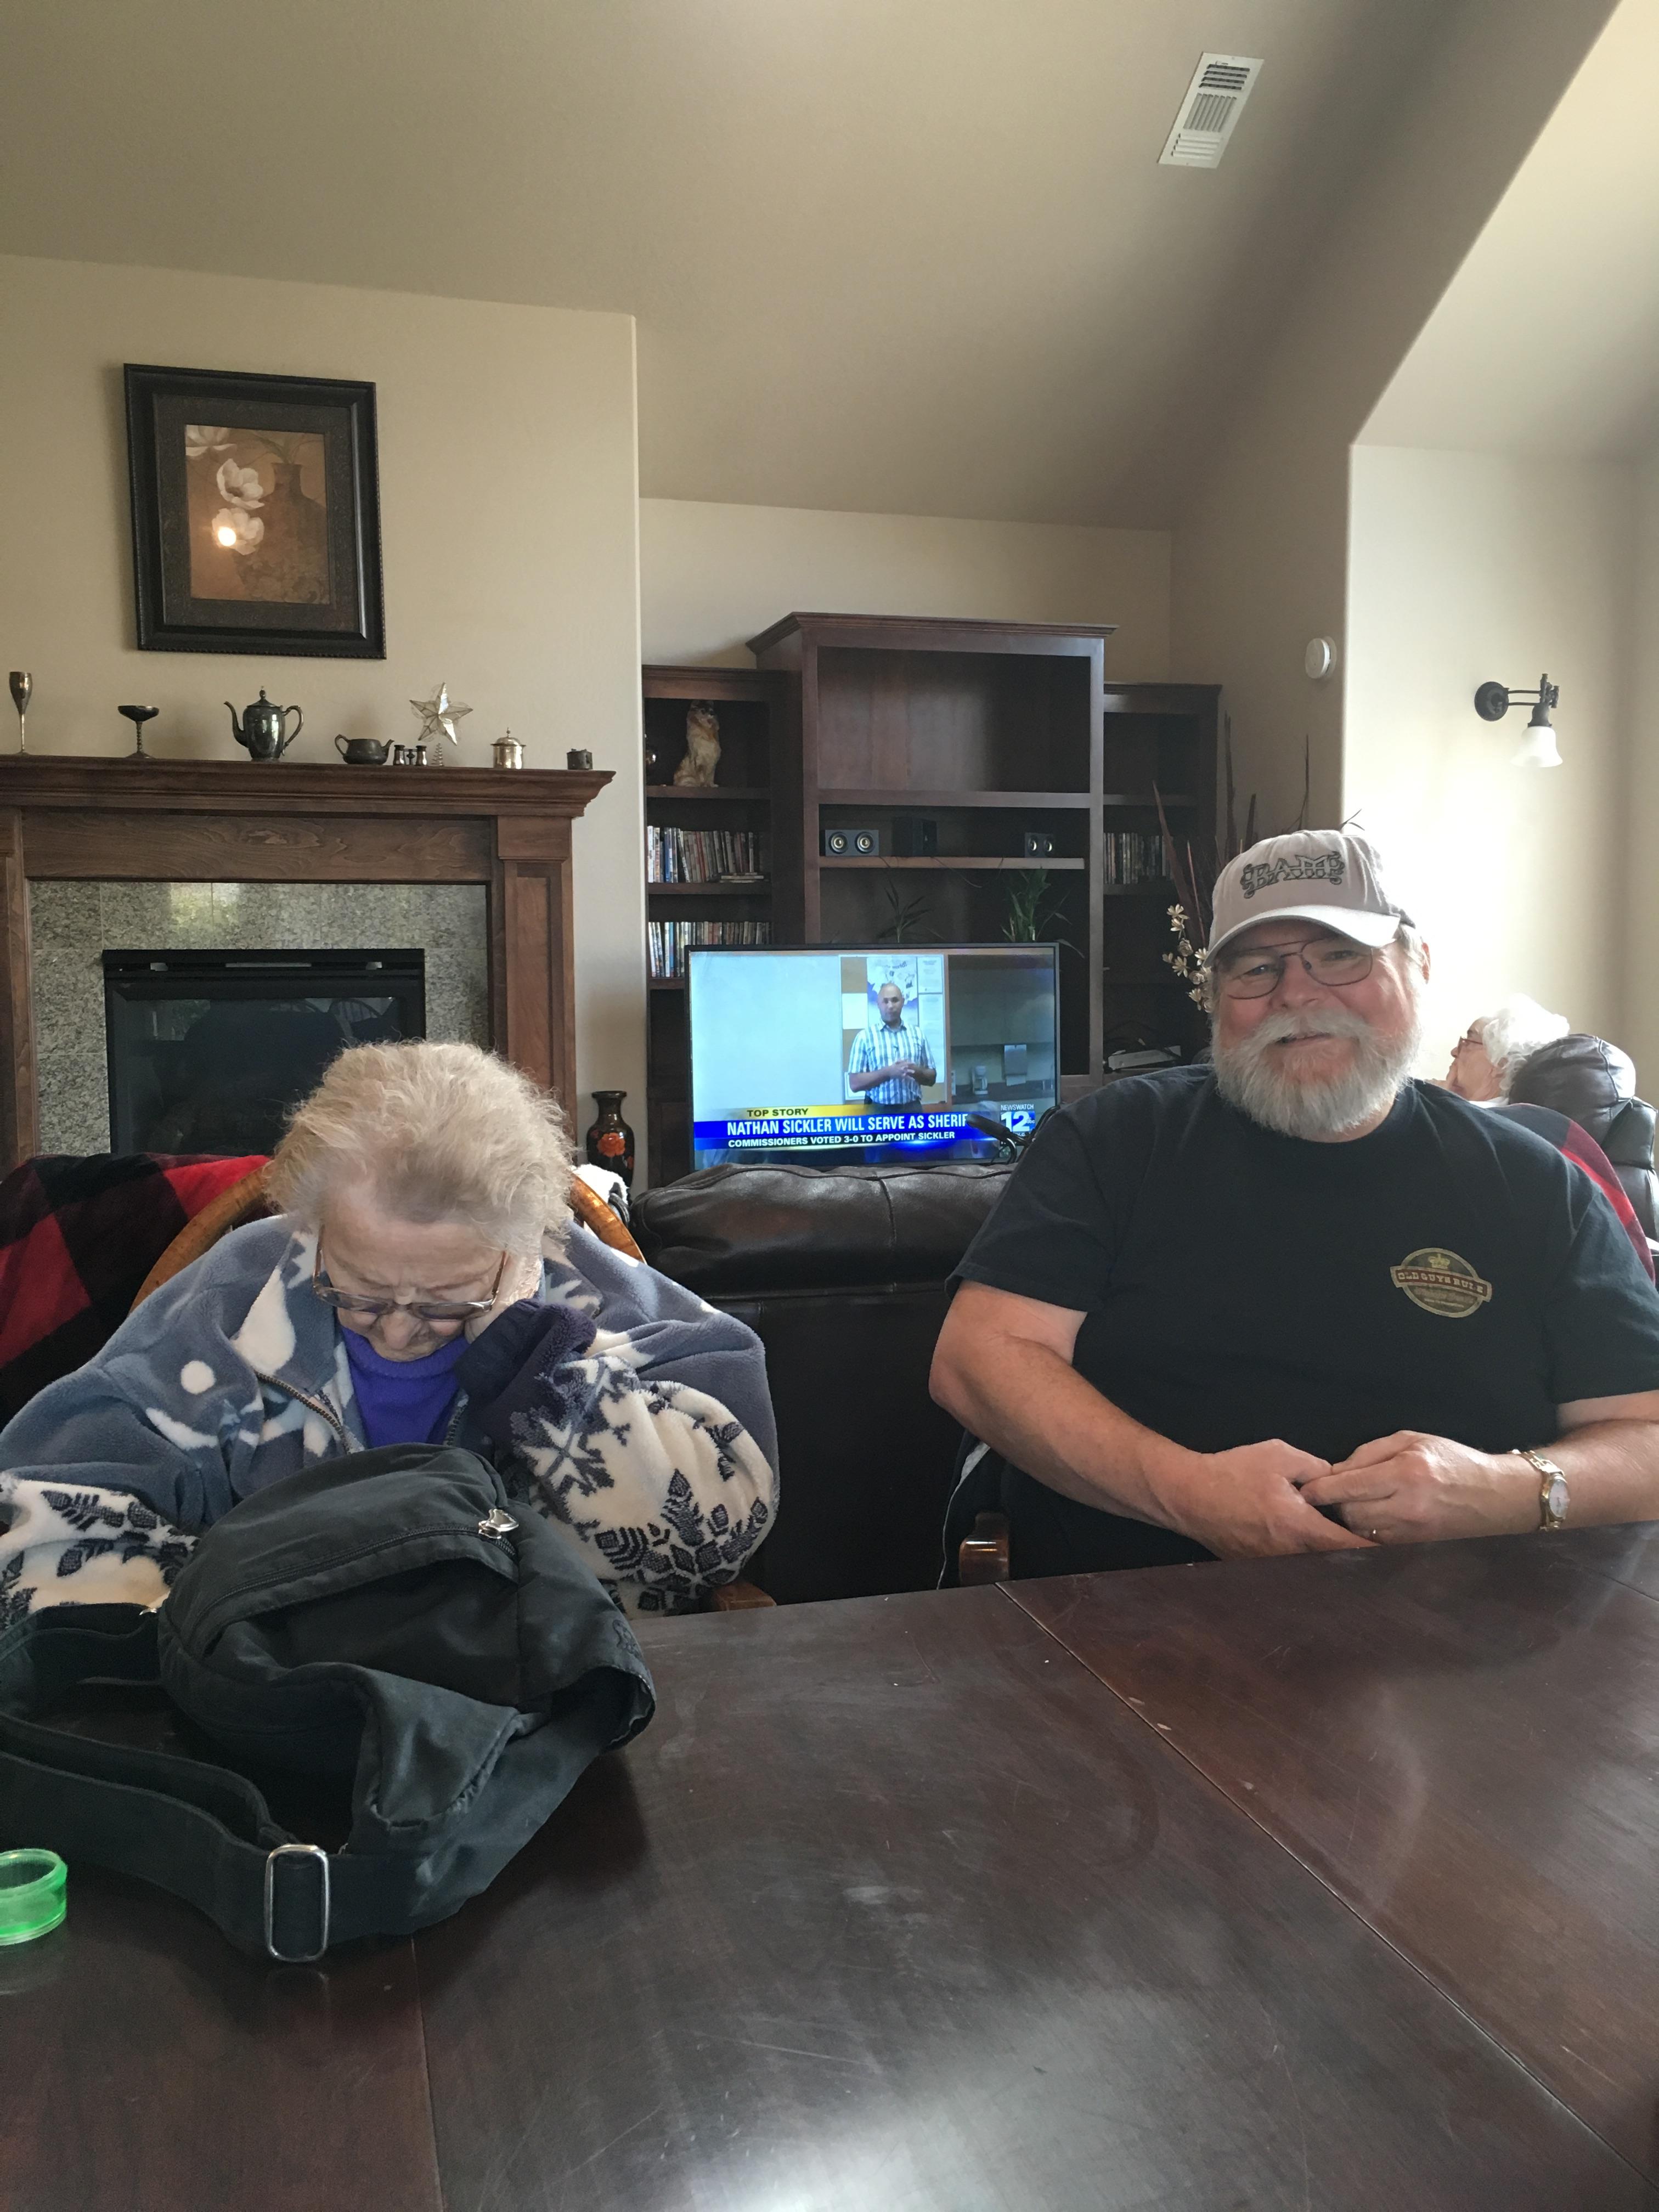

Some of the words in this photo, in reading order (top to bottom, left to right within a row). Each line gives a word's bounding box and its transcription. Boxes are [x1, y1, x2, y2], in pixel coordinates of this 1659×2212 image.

[727, 1120, 779, 1136] NATHAN
[783, 1118, 832, 1134] SICKLER
[835, 1116, 865, 1131] WILL
[868, 1115, 905, 1130] SERVE
[908, 1115, 924, 1129] AS
[928, 1113, 968, 1128] SHERIF
[1001, 1111, 1030, 1132] 12
[728, 1137, 808, 1148] COMMISSIONERS
[810, 1136, 842, 1144] VOTED
[844, 1135, 859, 1143] 3-0
[860, 1134, 873, 1142] TO
[875, 1132, 916, 1142] APPOINT
[918, 1131, 955, 1140] SICKLER
[1397, 1272, 1420, 1280] OLD
[1420, 1273, 1452, 1284] GUYS
[1453, 1277, 1484, 1294] RULE
